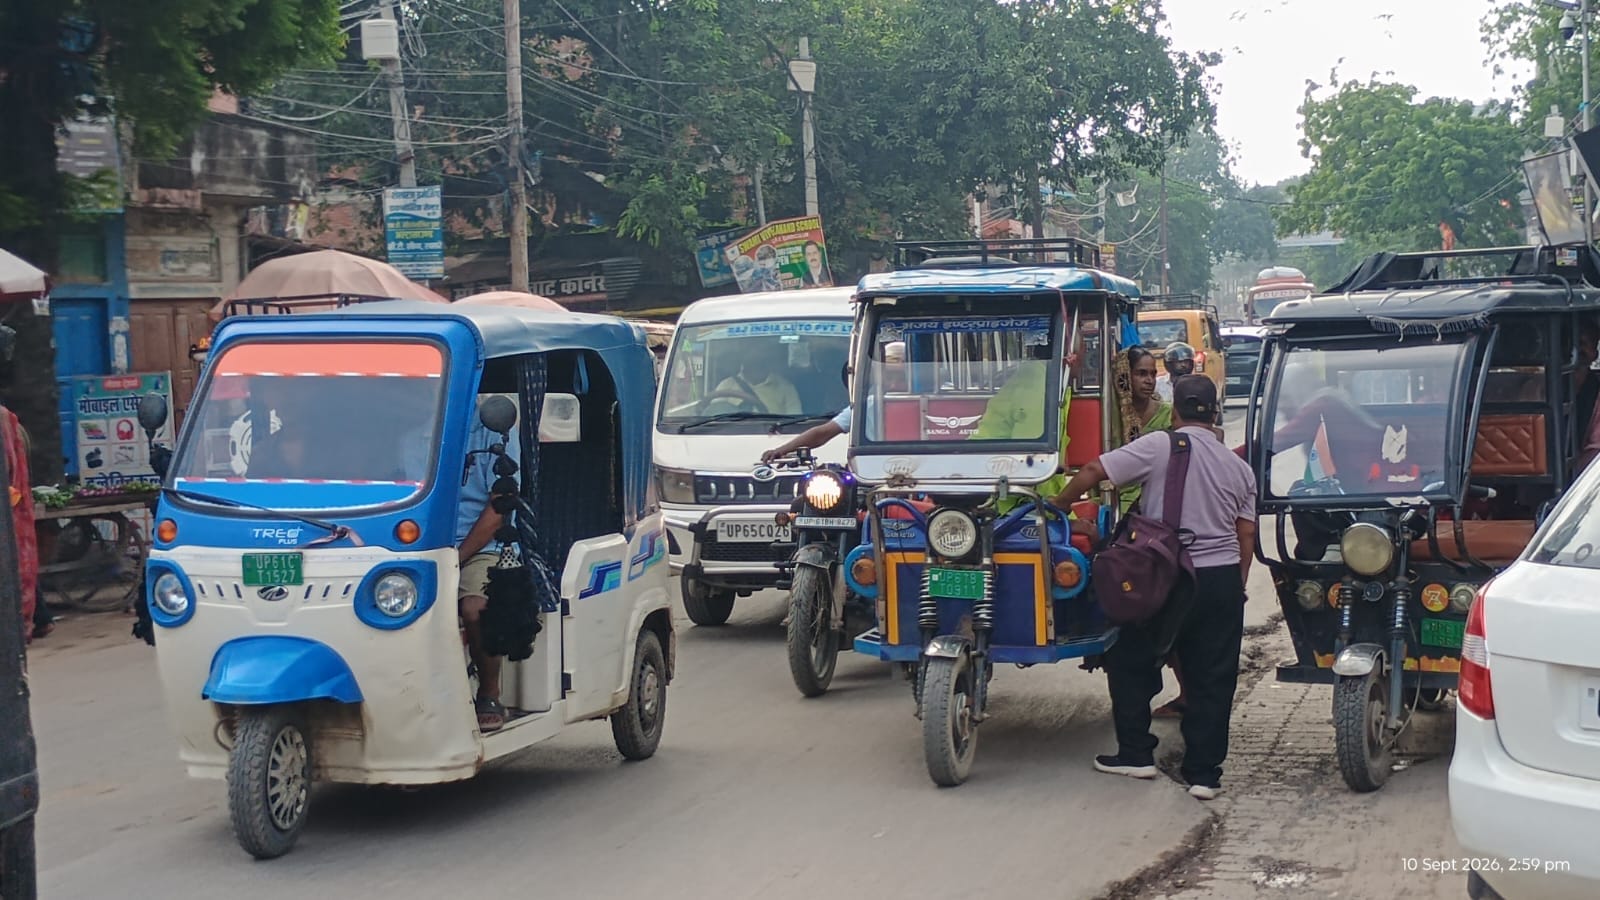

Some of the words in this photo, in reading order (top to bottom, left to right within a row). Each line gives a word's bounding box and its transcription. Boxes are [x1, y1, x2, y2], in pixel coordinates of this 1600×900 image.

[796, 218, 820, 232] SCHOOL
[751, 324, 780, 333] INDIA
[78, 394, 120, 414] मोबाइल
[256, 555, 295, 569] UP61C
[257, 570, 295, 583] T1527
